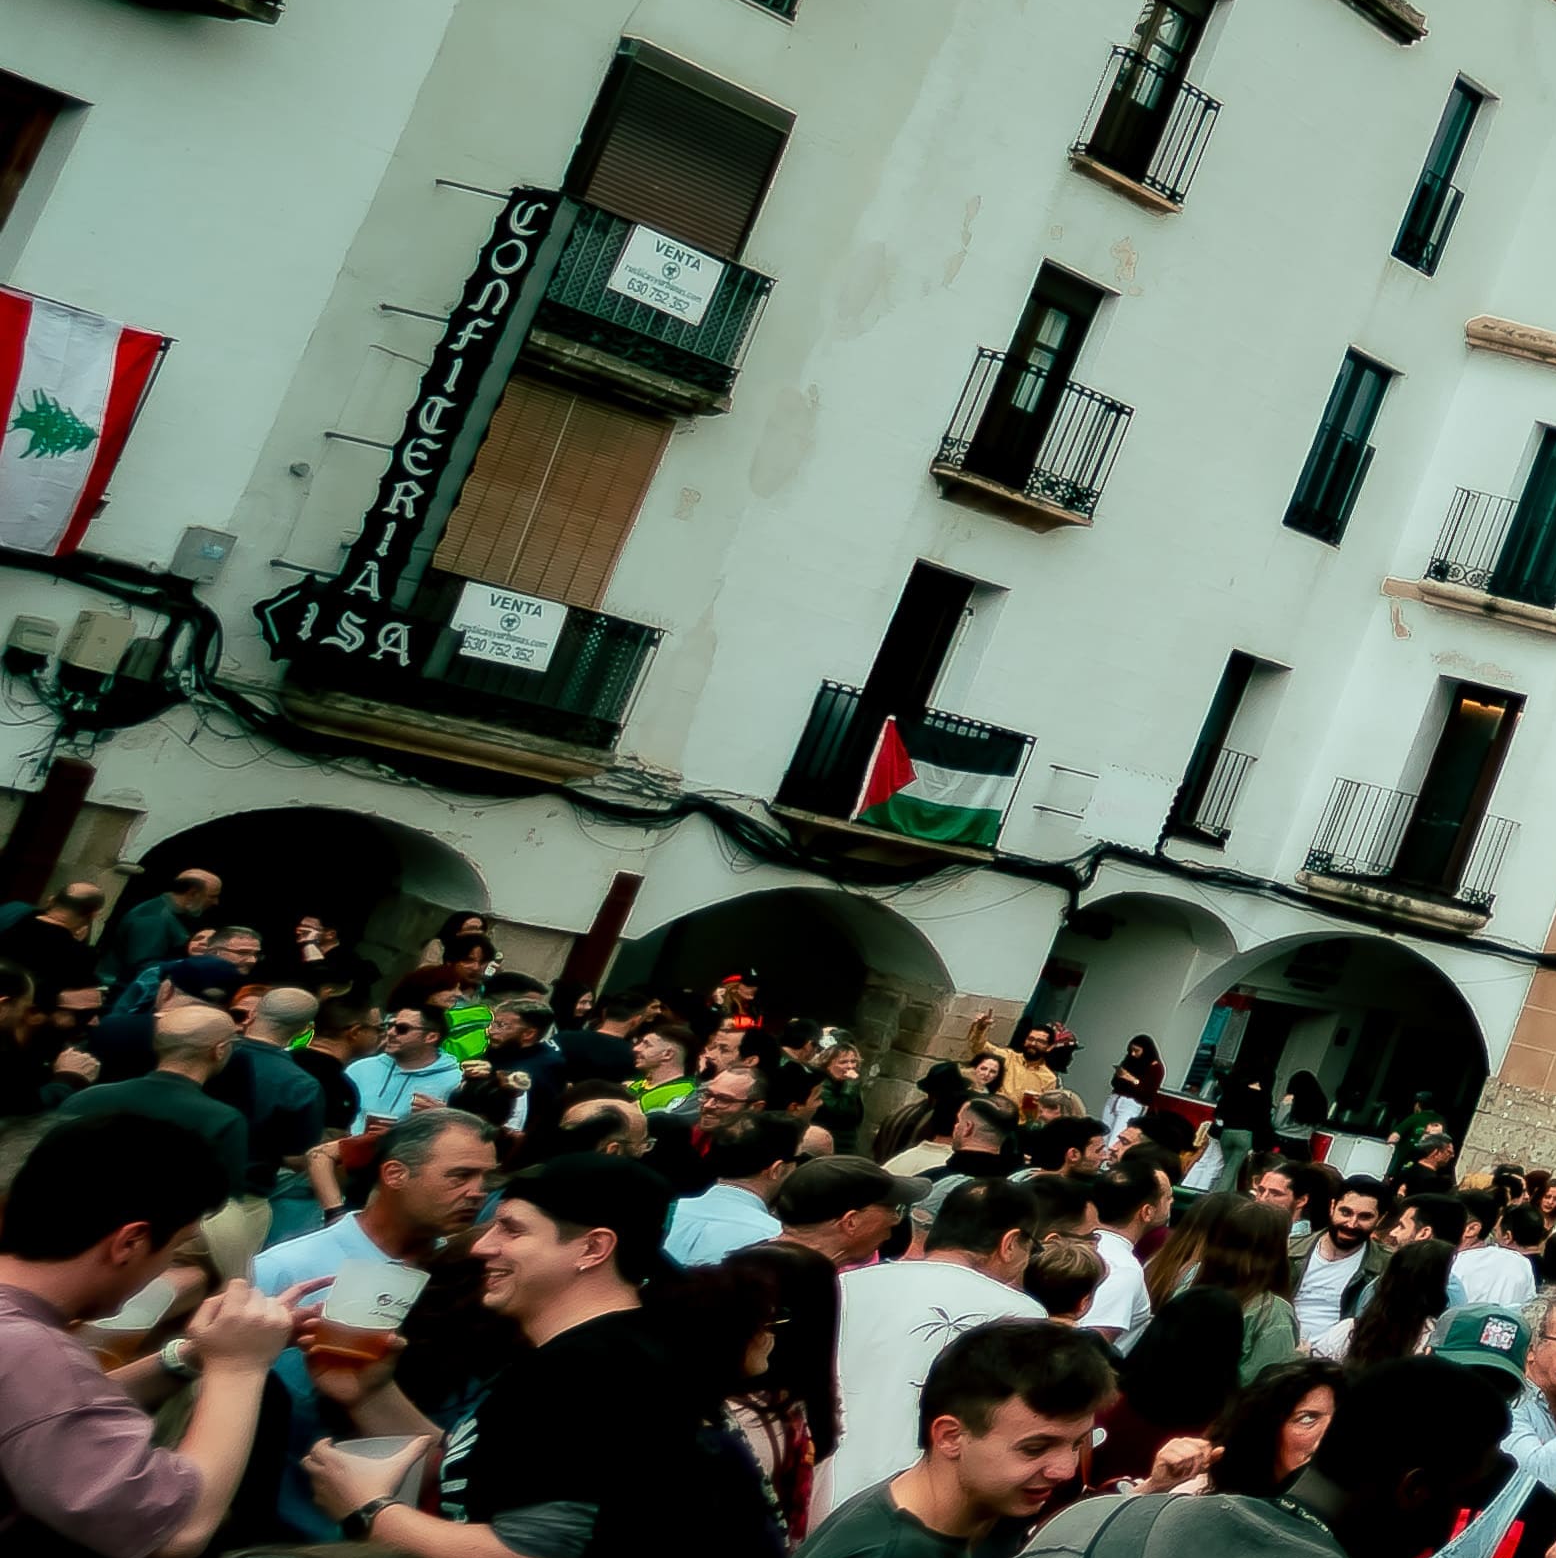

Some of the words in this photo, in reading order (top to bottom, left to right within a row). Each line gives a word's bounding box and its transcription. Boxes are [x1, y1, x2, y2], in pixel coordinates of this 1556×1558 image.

[655, 240, 702, 272] VENTA
[627, 278, 648, 296] 630
[650, 286, 670, 305] 752
[669, 295, 690, 314] 352
[344, 200, 549, 603] CONFITERIA
[490, 593, 543, 618] VENTA
[296, 602, 413, 667] ISA
[489, 641, 512, 658] 752
[512, 647, 535, 662] 352
